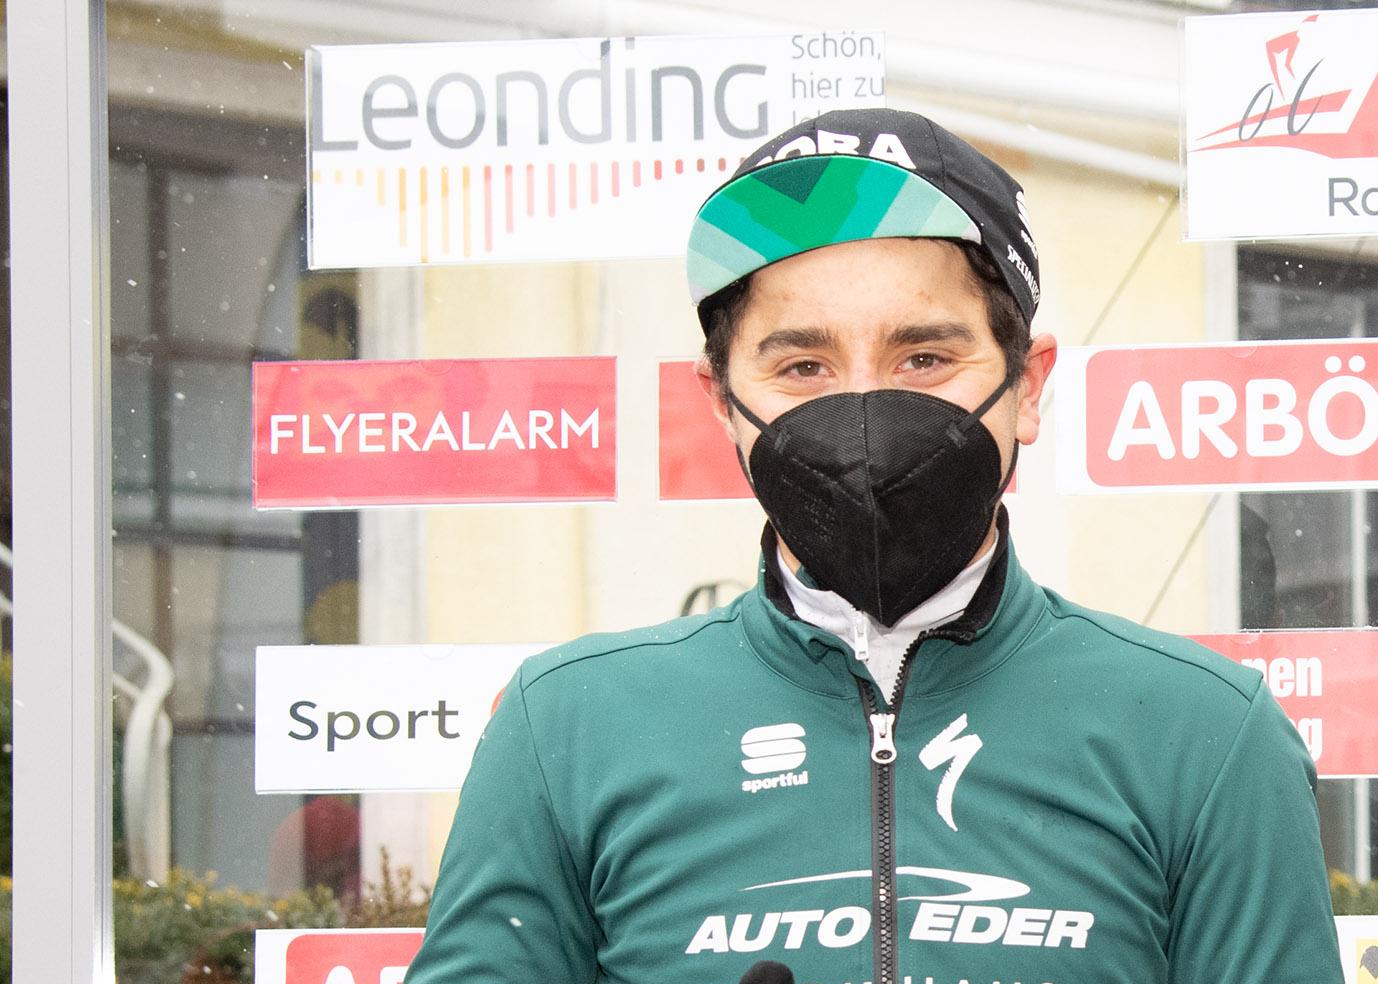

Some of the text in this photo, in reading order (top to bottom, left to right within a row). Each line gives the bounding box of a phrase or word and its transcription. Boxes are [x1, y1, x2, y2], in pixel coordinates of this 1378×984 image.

[792, 31, 882, 61] Schön,
[792, 72, 885, 99] hier zu
[756, 129, 917, 169] ORA
[270, 408, 599, 454] FLYERALARM
[288, 700, 460, 752] Sport
[742, 770, 809, 793] sportful
[685, 903, 1095, 954] AUTO EDER
